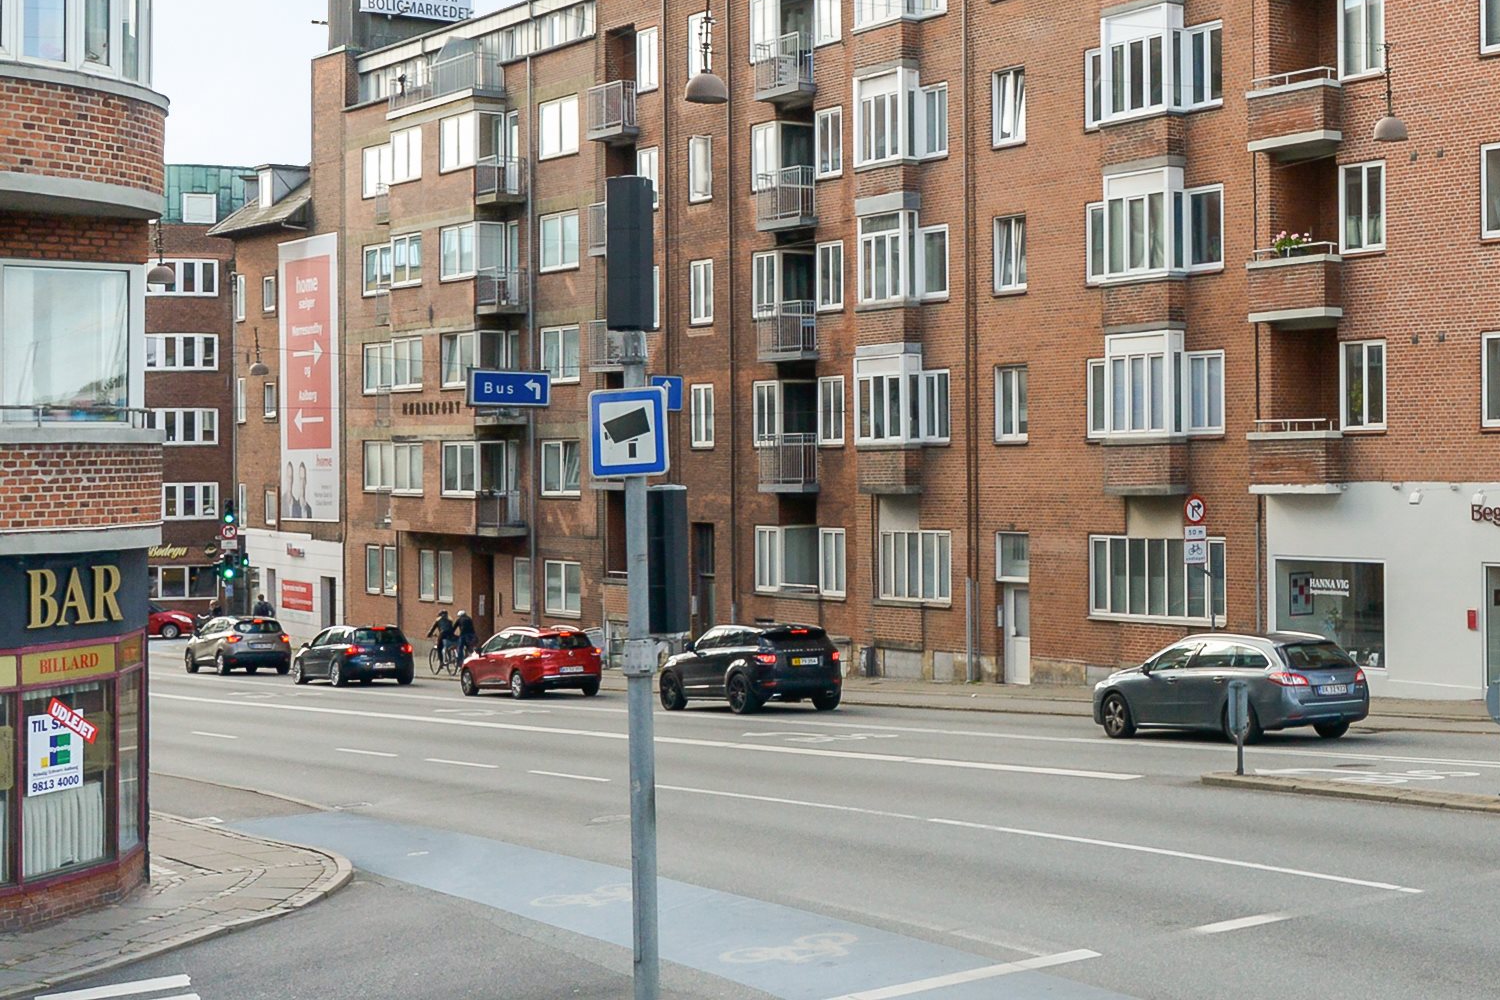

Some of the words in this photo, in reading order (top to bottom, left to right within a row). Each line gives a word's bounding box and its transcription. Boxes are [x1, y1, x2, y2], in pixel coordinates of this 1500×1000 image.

[296, 276, 319, 294] home
[484, 381, 514, 395] Bus
[1310, 578, 1335, 588] HANNA
[1336, 579, 1349, 589] VIG
[26, 564, 124, 629] BAR
[40, 653, 99, 674] BILLARD
[32, 720, 48, 732] TIL
[51, 702, 95, 739] UDLEJET
[32, 779, 55, 793] 9813
[57, 775, 79, 787] 4000
